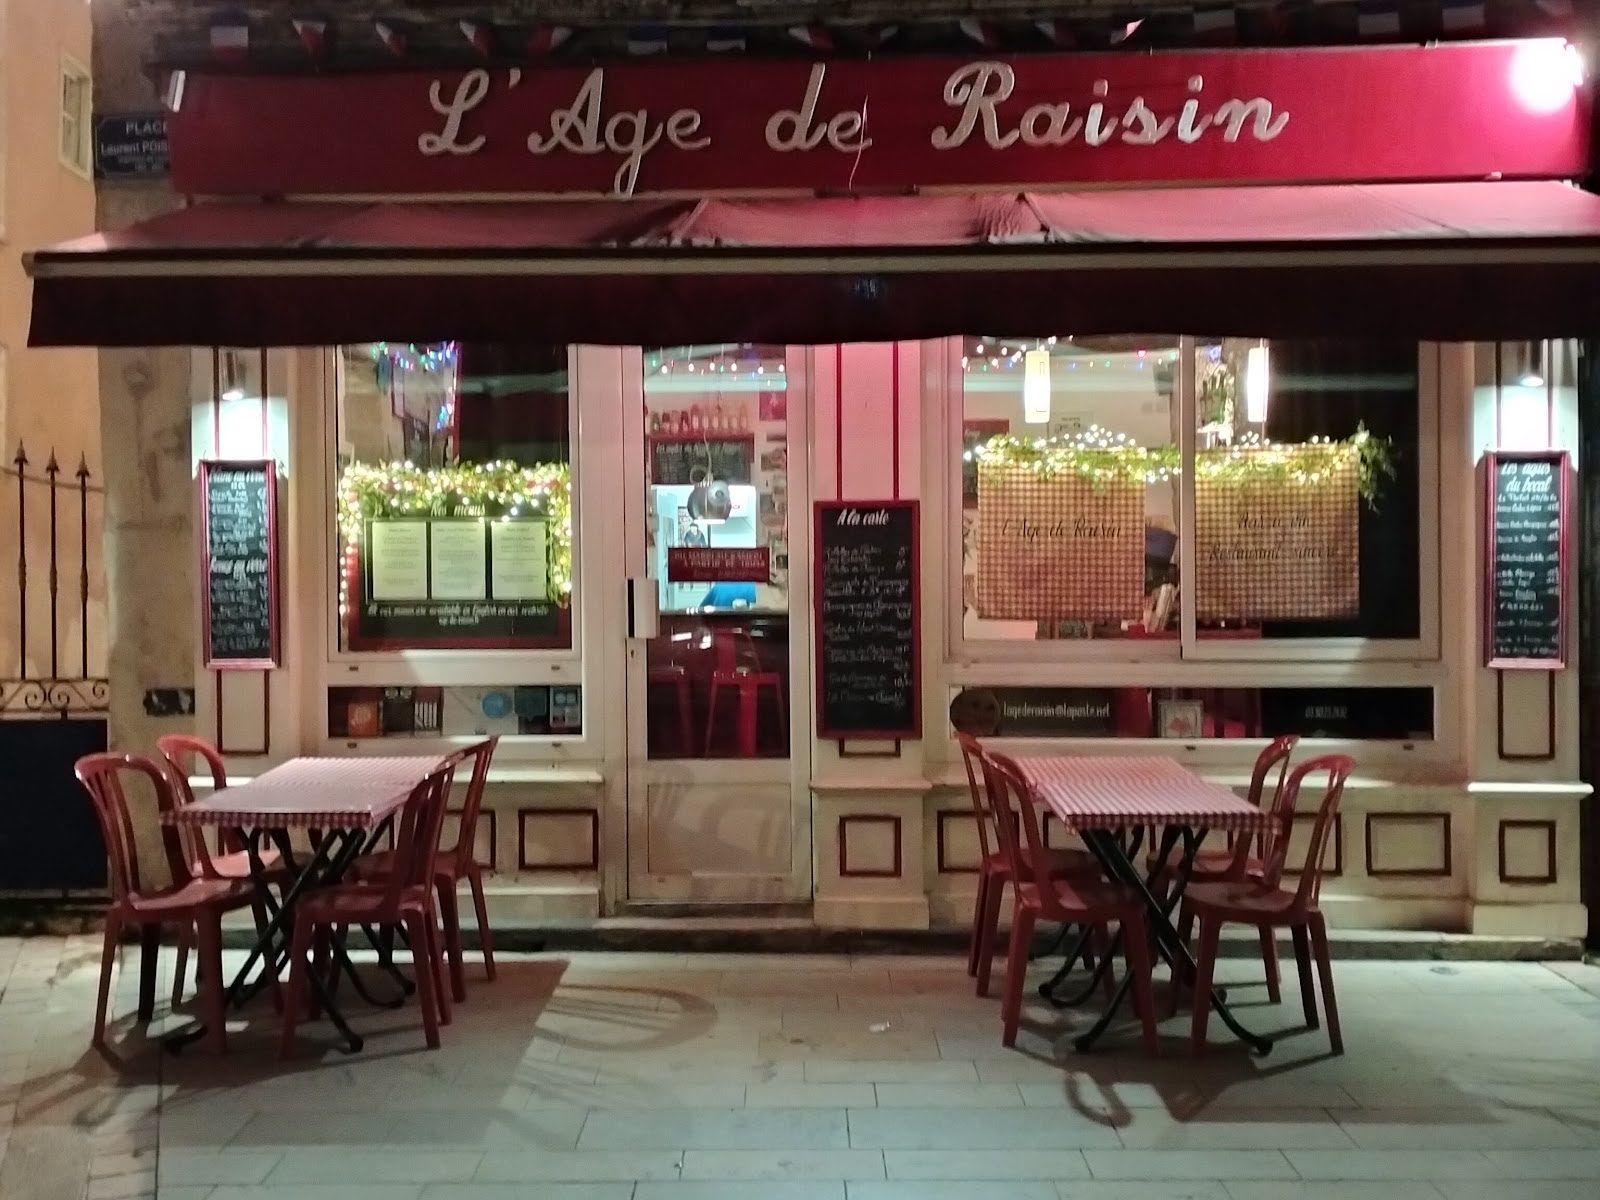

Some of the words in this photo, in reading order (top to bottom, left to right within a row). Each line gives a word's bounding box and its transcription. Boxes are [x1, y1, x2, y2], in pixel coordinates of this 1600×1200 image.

[418, 67, 712, 199] L'Age
[765, 62, 872, 152] de
[931, 60, 1290, 150] Raisin
[1506, 475, 1521, 492] du
[454, 504, 487, 517] menus
[862, 508, 889, 526] carte
